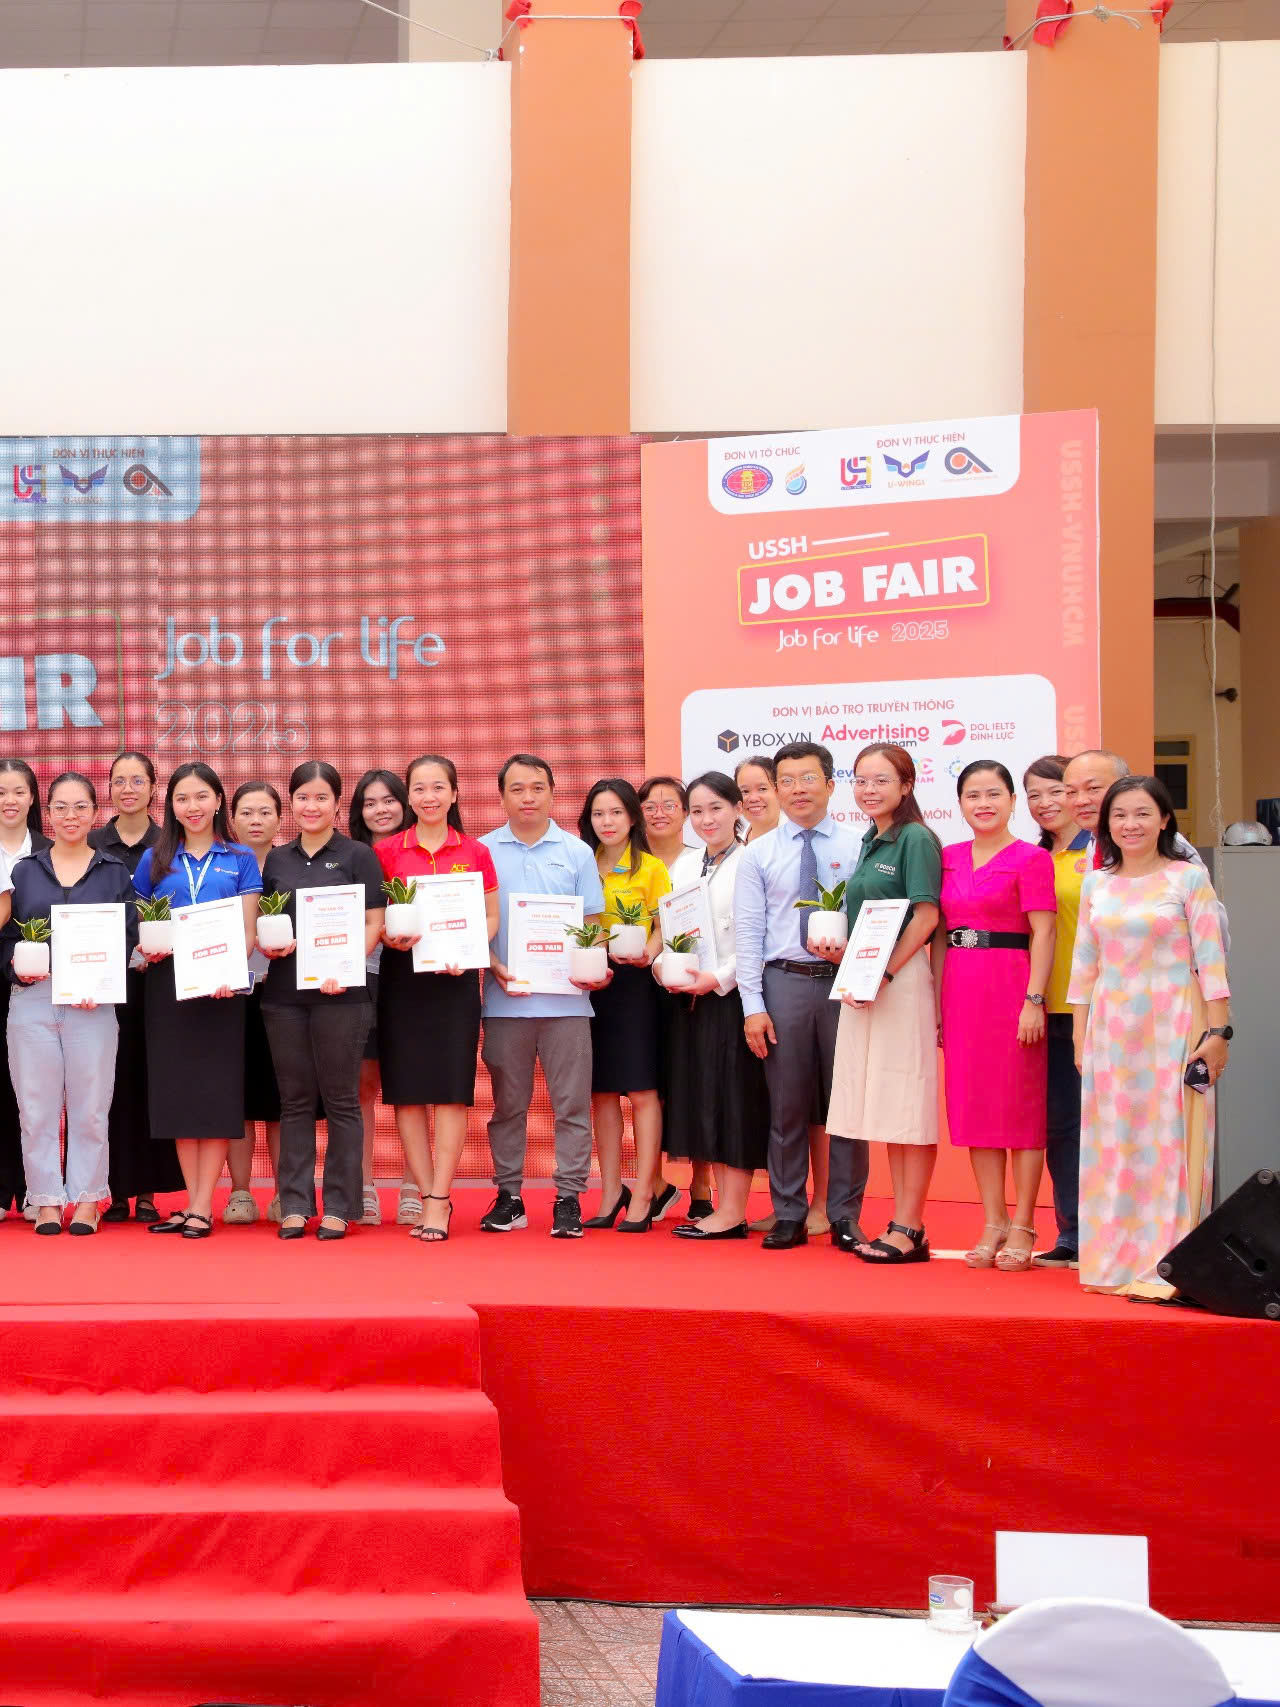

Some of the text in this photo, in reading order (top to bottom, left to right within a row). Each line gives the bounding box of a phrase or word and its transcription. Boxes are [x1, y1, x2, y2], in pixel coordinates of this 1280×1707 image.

[748, 535, 808, 560] USSH
[748, 555, 979, 615] JOB FAIR
[776, 619, 950, 653] Job for life 2025
[154, 616, 447, 681] Job for life
[154, 700, 311, 755] 2025
[821, 723, 930, 742] Advertising
[970, 721, 1016, 731] DOL IELTS
[970, 731, 996, 742] ĐÌNH
[742, 732, 811, 747] YBOXVN
[527, 943, 563, 951] JOB FAIR
